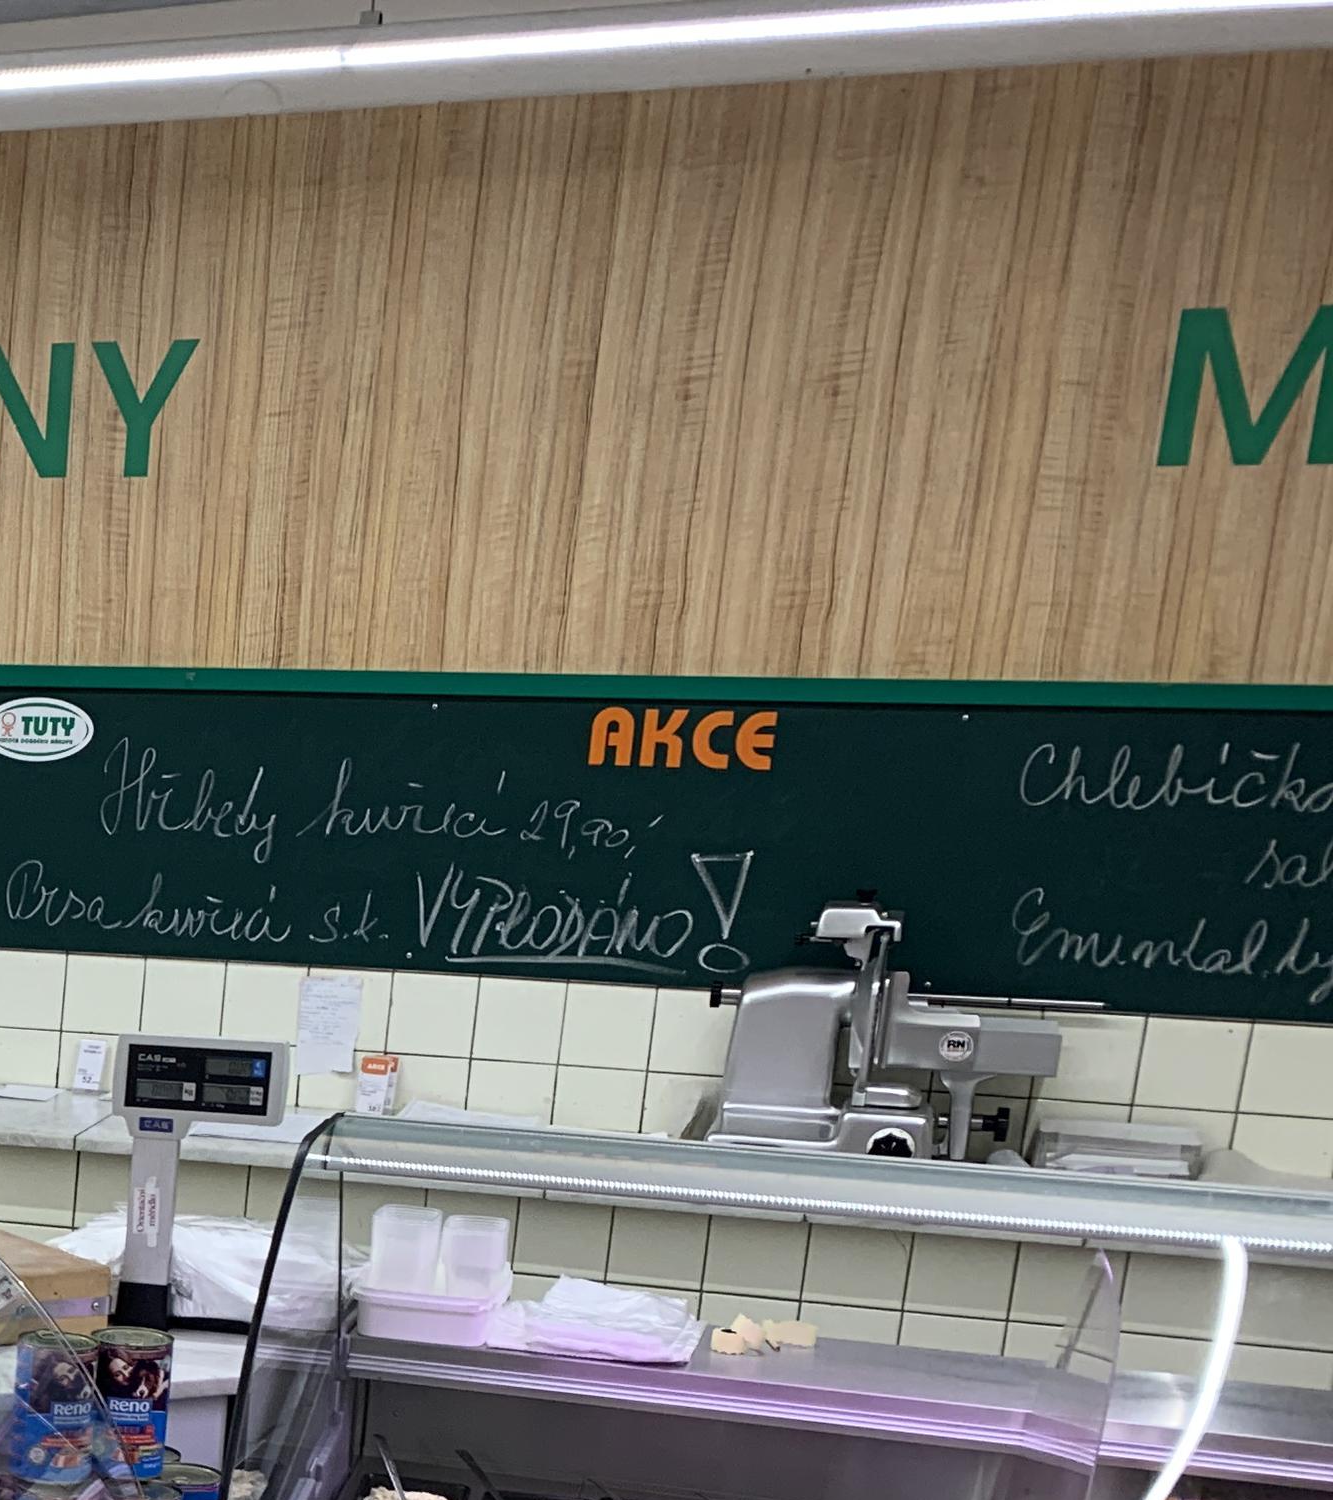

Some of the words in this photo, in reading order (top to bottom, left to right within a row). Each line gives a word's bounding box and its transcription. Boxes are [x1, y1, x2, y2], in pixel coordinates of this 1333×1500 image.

[1157, 304, 1333, 466] M
[21, 716, 75, 736] TUTY
[589, 707, 777, 769] AKCE
[138, 1053, 161, 1062] CAS
[54, 1402, 92, 1416] Reno
[109, 1399, 151, 1414] Reno
